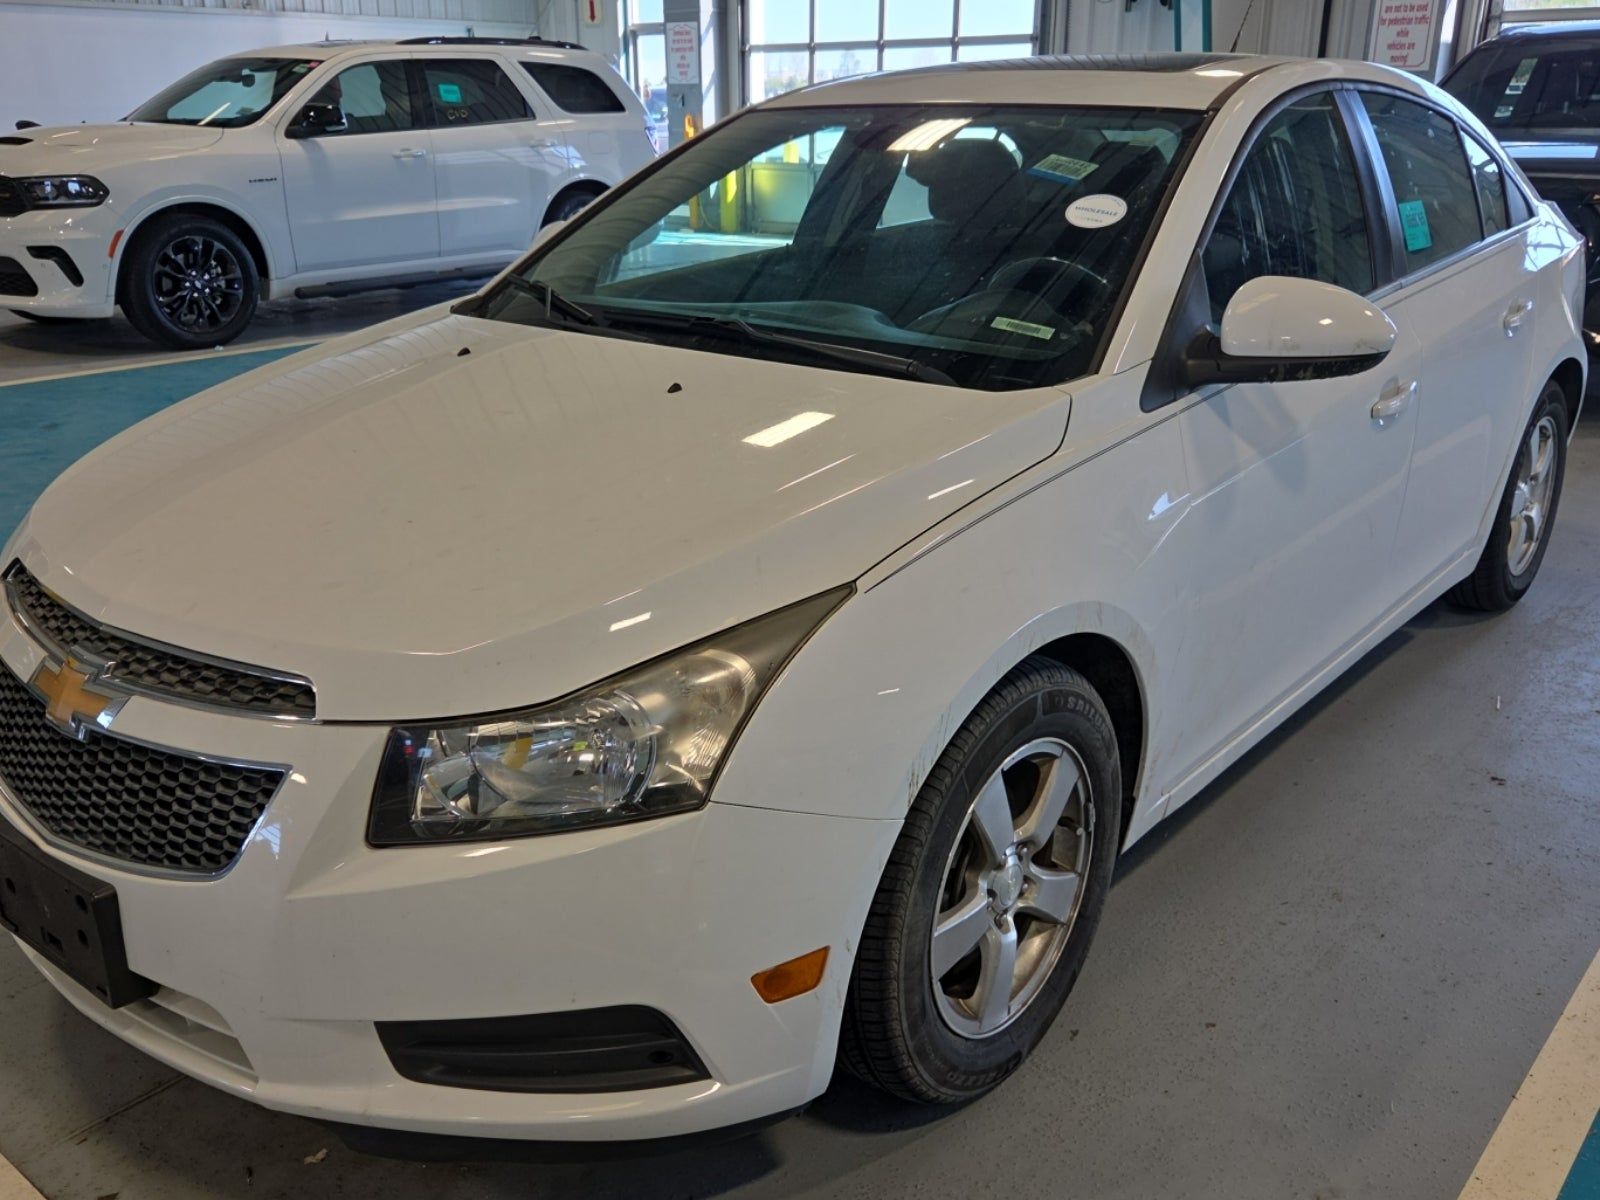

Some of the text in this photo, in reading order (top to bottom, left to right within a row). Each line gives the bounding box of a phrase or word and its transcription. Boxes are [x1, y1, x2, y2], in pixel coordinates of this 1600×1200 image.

[1385, 6, 1393, 14] are
[1394, 5, 1402, 13] not
[1409, 4, 1415, 12] be
[1416, 3, 1429, 12] used
[1387, 15, 1413, 27] pedestrian
[1414, 14, 1430, 24] traffic
[1396, 27, 1409, 37] while
[1387, 40, 1406, 50] vehicles
[1075, 206, 1119, 216] WHOLESALE
